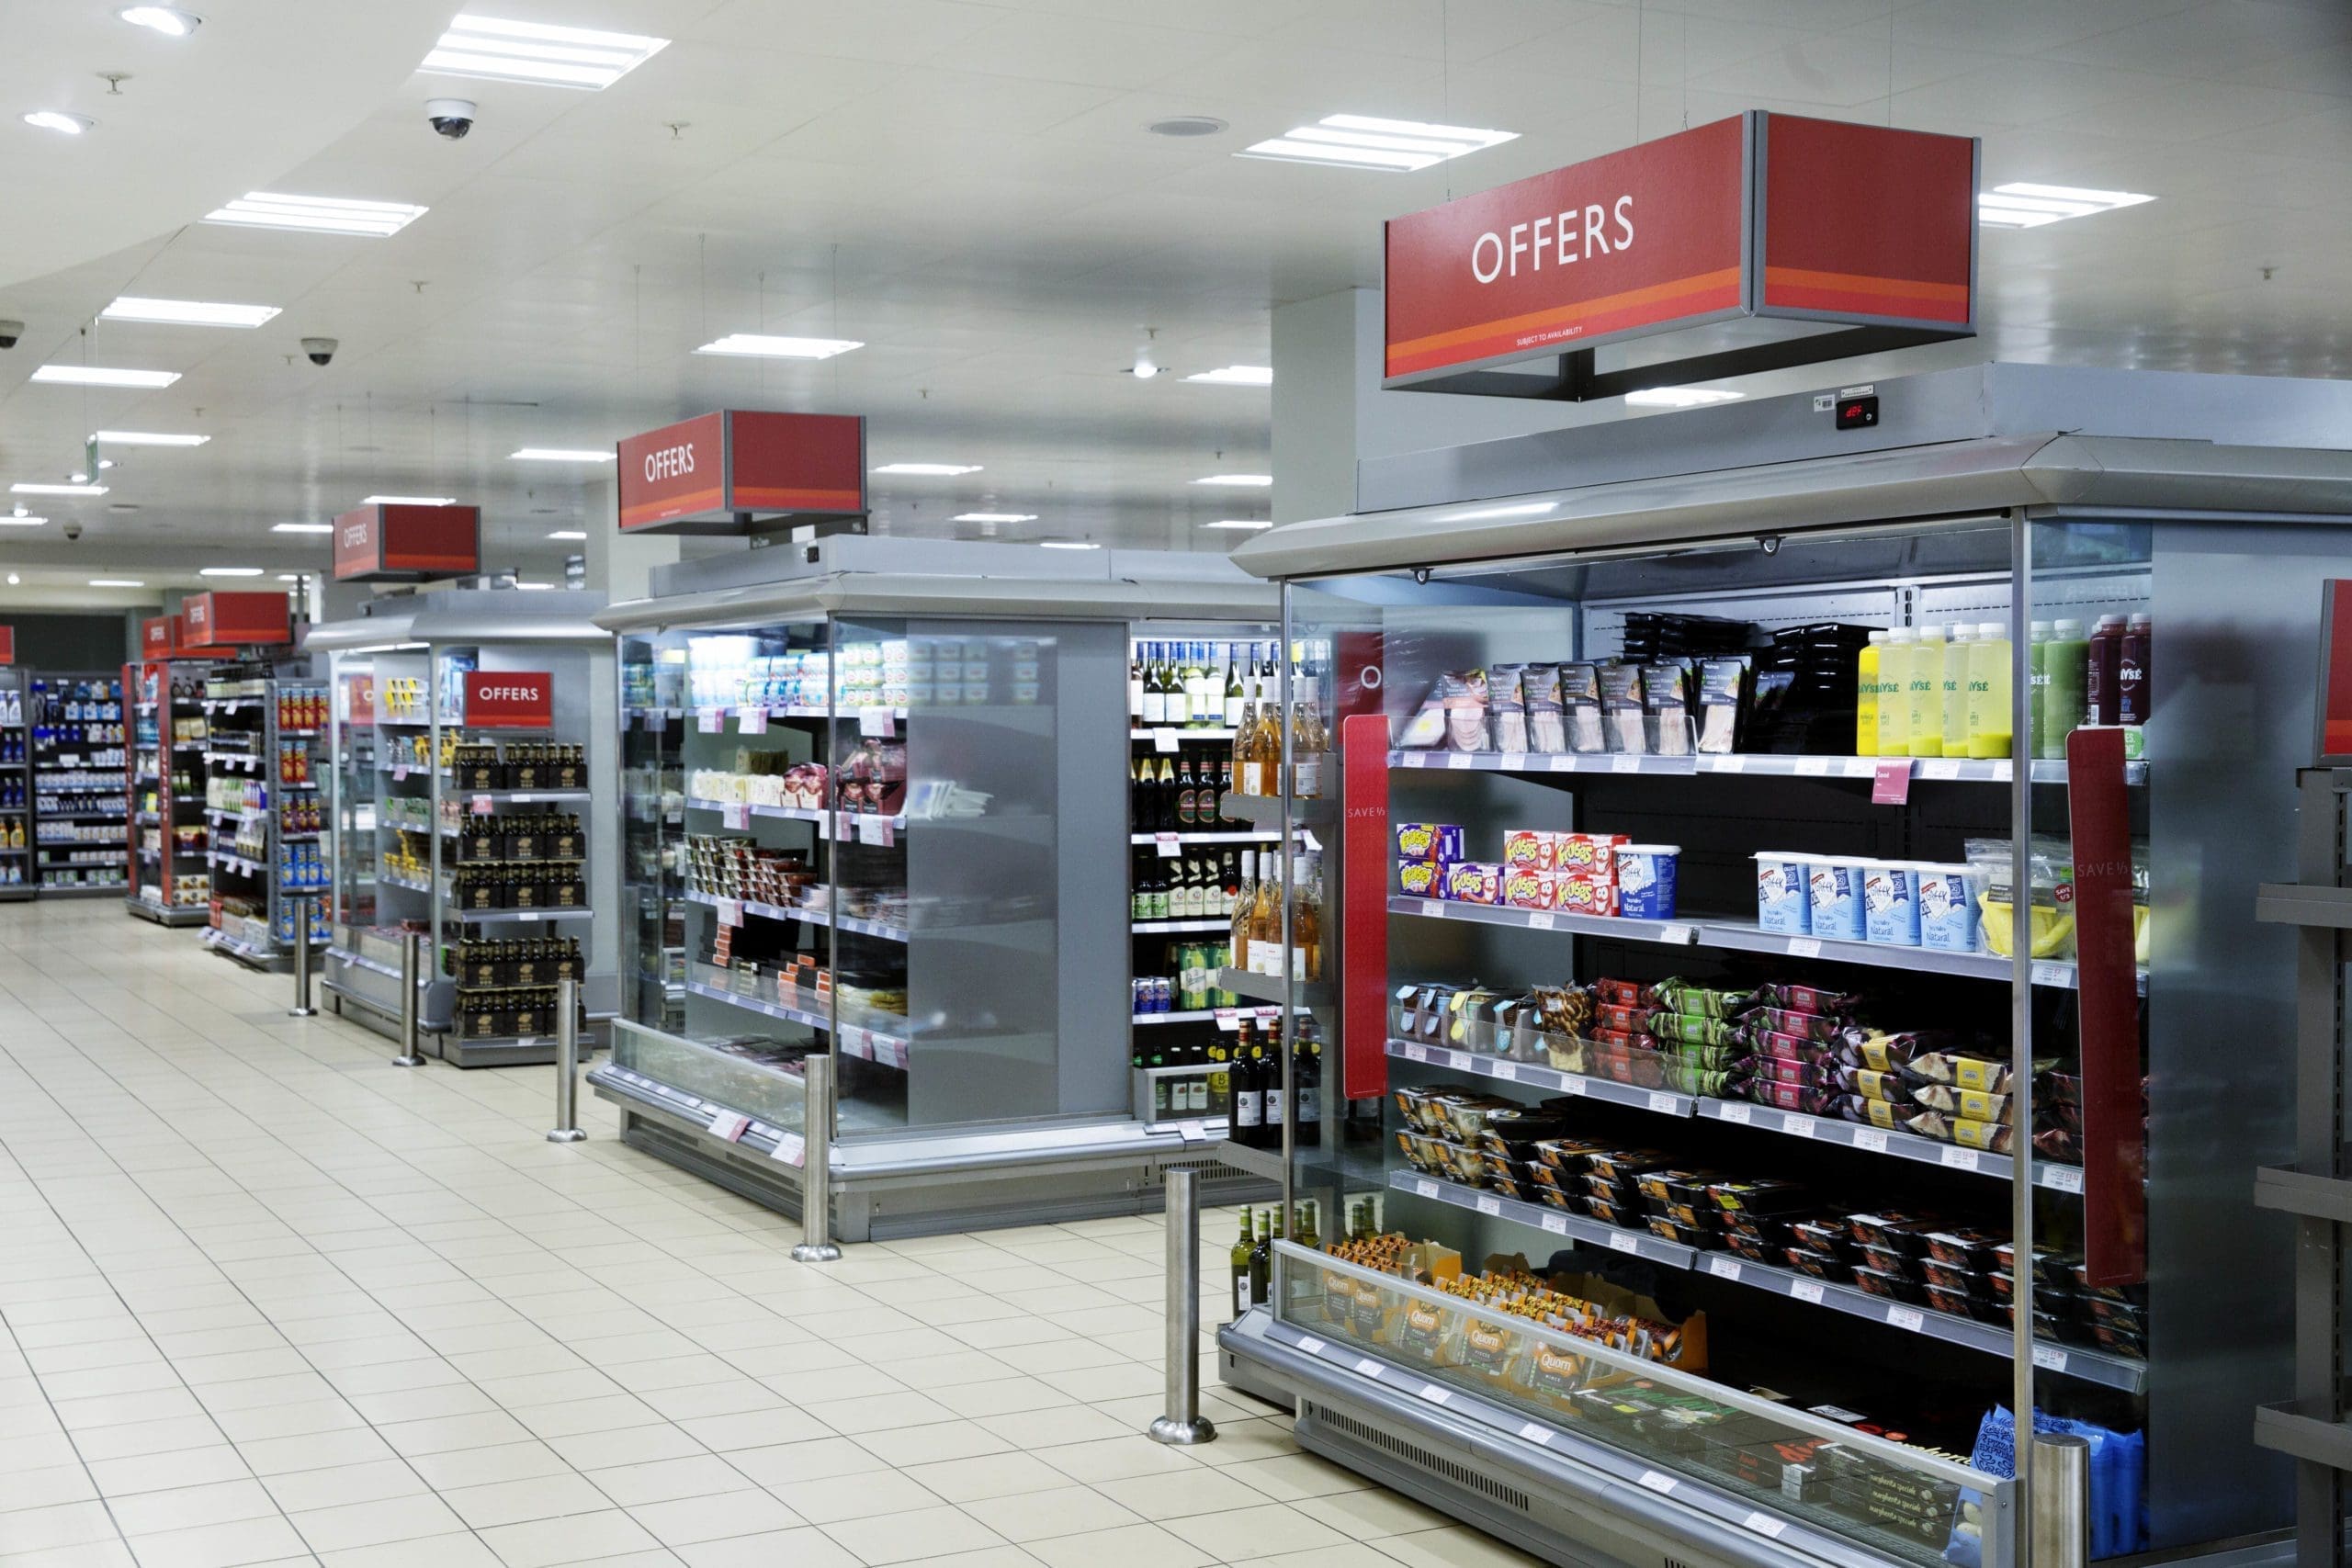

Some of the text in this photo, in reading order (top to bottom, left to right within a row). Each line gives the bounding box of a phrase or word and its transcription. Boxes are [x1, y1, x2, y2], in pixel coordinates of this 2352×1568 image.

[1472, 195, 1634, 284] OFFERS
[1516, 335, 1538, 346] SUBJECT
[1547, 326, 1583, 340] AVAILABILITY
[644, 443, 695, 483] OFFERS
[344, 523, 368, 549] OFFERS
[480, 687, 539, 702] OFFERS
[1348, 807, 1374, 818] SAVE
[2077, 862, 2114, 877] SAVE
[2055, 886, 2071, 896] SAVE
[1623, 902, 1645, 912] Natural
[1764, 915, 1785, 926] Natural
[1815, 920, 1837, 931] Natural
[1871, 926, 1894, 936] Natural
[1926, 932, 1951, 942] Natural
[1328, 1276, 1348, 1292] Quorn
[1356, 1289, 1376, 1303] Quorn
[1411, 1310, 1435, 1327] Quorn
[1472, 1329, 1498, 1348] Quorn
[1541, 1353, 1572, 1371] Quorn
[1986, 1437, 2010, 1452] PIZZA
